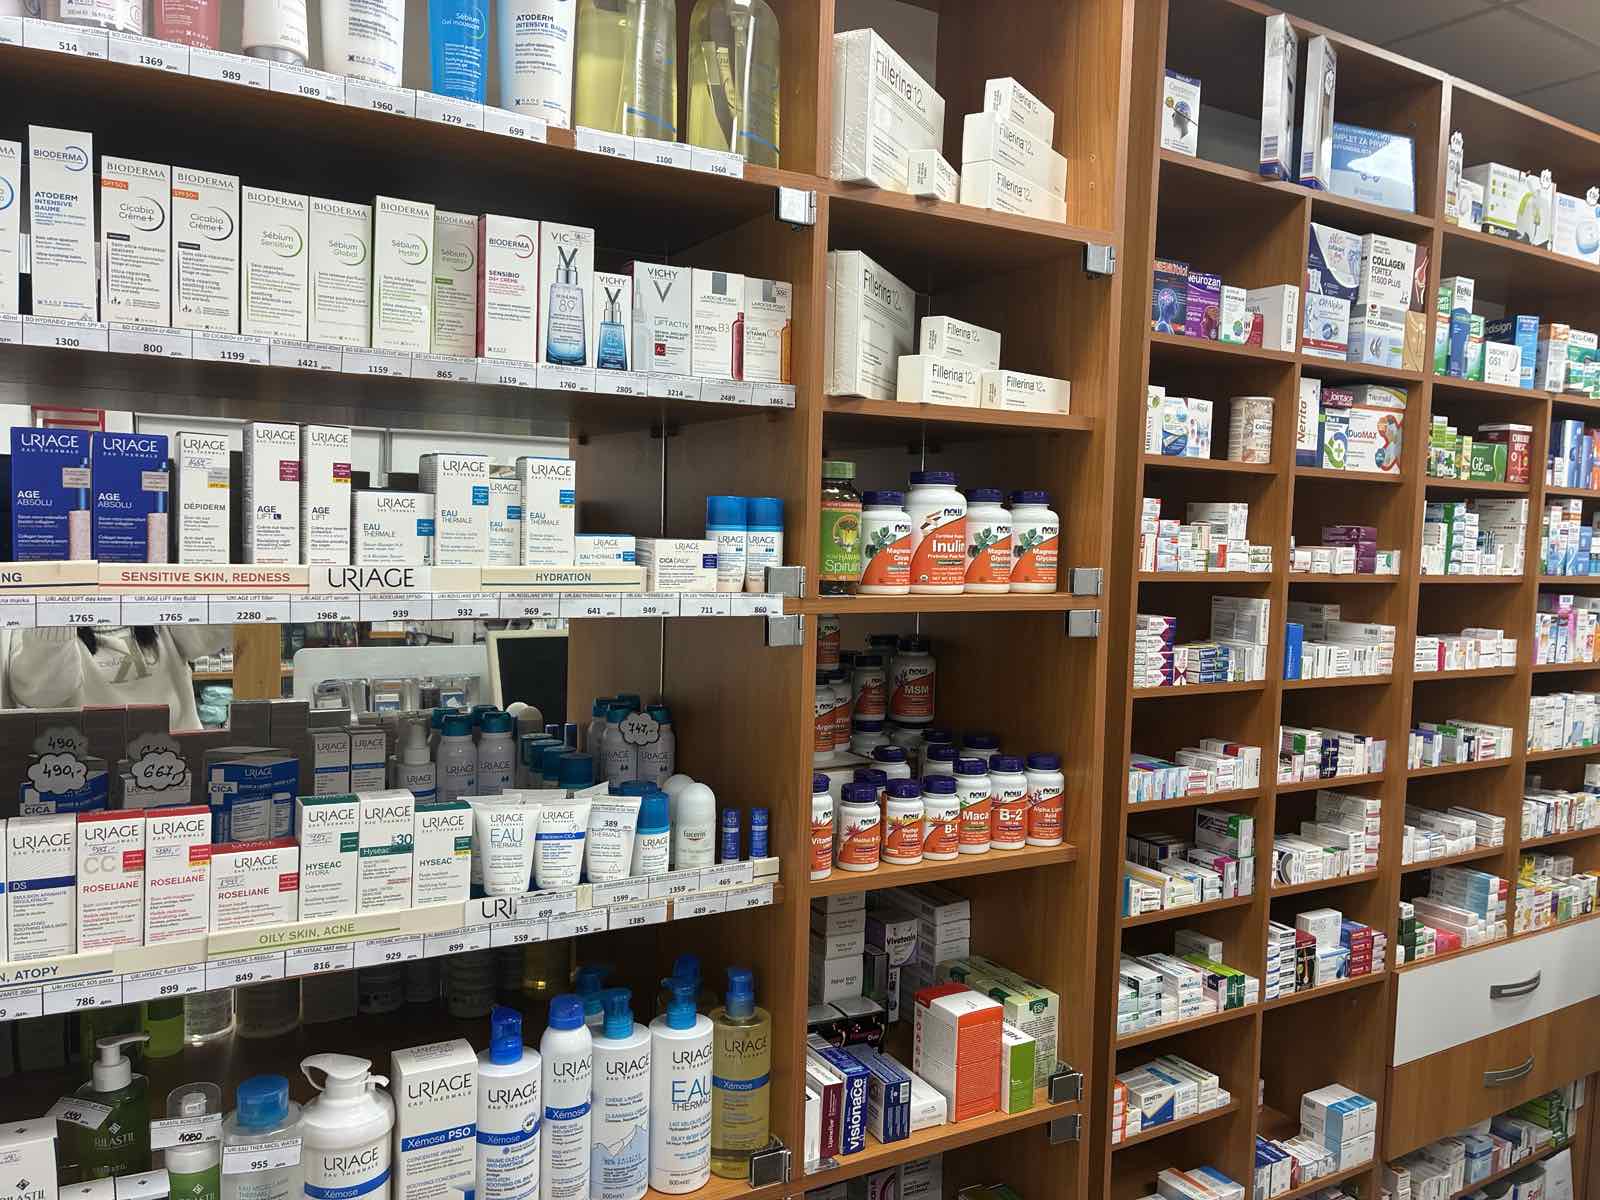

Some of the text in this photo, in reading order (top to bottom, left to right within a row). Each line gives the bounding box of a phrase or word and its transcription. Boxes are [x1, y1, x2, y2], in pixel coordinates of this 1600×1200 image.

[516, 14, 553, 22] ATODERM
[58, 41, 78, 53] 514
[139, 54, 163, 67] 1369
[221, 69, 241, 82] 989
[875, 51, 922, 110] Fillerina 12
[298, 84, 321, 97] 1089
[372, 99, 393, 112] 1960
[442, 114, 462, 124] 1279
[509, 127, 524, 136] 699
[33, 149, 83, 162] BIODERMA
[656, 156, 672, 164] 1100
[107, 162, 165, 178] BIODERMA
[178, 173, 234, 188] BIODERMA
[35, 192, 78, 201] ATODERM
[248, 192, 303, 208] BIODERMA
[35, 200, 72, 208] INTENSIVE
[35, 205, 60, 213] BAUME
[120, 203, 154, 215] Cicabio
[314, 202, 367, 218] BIODERMA
[380, 202, 429, 217] BIODERMA
[489, 238, 530, 249] BIODERMA
[1372, 256, 1406, 270] COLLAGEN
[489, 270, 520, 279] SENSIBIO
[648, 268, 678, 278] VICHY
[1372, 266, 1392, 277] FORTEX
[599, 276, 626, 286] VICHY
[1388, 278, 1401, 288] PLUS
[55, 337, 80, 347] 1300
[143, 344, 163, 353] 800
[220, 351, 245, 361] 1199
[297, 359, 318, 368] 1421
[368, 365, 388, 374] 1159
[932, 364, 973, 383] Fillerina 12
[499, 376, 517, 384] 1159
[559, 381, 576, 389] 1760
[1007, 376, 1043, 392] Fillerina 12
[256, 430, 295, 441] URIAGE
[312, 432, 348, 444] URIAGE
[1349, 430, 1376, 439] DuoMAX
[22, 434, 79, 448] URIAGE
[104, 438, 158, 453] URIAGE
[184, 440, 225, 450] URIAGE
[443, 461, 485, 473] URIAGE
[531, 465, 571, 478] URIAGE
[489, 483, 519, 493] URIAGE
[17, 491, 40, 499] AGE
[98, 493, 120, 501] AGE
[17, 498, 52, 506] ABSOLU
[98, 500, 132, 508] ABSOLU
[377, 499, 415, 510] URIAGE
[441, 510, 457, 518] EAU
[530, 512, 546, 520] EAU
[943, 508, 962, 517] now
[1041, 526, 1057, 535] now
[122, 572, 291, 583] SENSITIVE SKIN, REDNESS
[329, 568, 415, 591] URIAGE
[535, 572, 592, 582] HYDRATION
[457, 608, 473, 616] 932
[524, 607, 539, 615] 969
[587, 606, 601, 615] 641
[643, 606, 656, 614] 949
[159, 614, 182, 622] 1765
[237, 612, 261, 620] 2280
[317, 612, 338, 620] 1968
[909, 667, 928, 676] now
[904, 685, 929, 696] MSM
[211, 785, 233, 793] CICA
[309, 809, 354, 823] URIAGE
[365, 806, 411, 820] URIAGE
[490, 814, 524, 822] URIAGE
[543, 810, 575, 821] URIAGE
[963, 811, 989, 820] Maca
[1000, 809, 1022, 820] B-2
[423, 816, 464, 829] URIAGE
[84, 824, 138, 842] URIAGE
[153, 820, 205, 837] URIAGE
[491, 828, 524, 842] EAU
[13, 833, 71, 850] URIAGE
[83, 856, 116, 874] CC
[234, 855, 278, 870] URIAGE
[306, 861, 342, 871] HYSEAC
[420, 858, 452, 867] HYSEAC
[13, 881, 26, 890] DS
[150, 874, 205, 888] ROSELIANE
[83, 880, 139, 894] ROSELIANE
[218, 888, 270, 899] ROSELIANE
[613, 894, 629, 902] 1599
[259, 932, 284, 944] OILY
[323, 923, 354, 936] ACNE
[514, 935, 528, 943] 559
[449, 943, 463, 951] 899
[385, 952, 401, 960] 929
[313, 962, 330, 970] 816
[15, 966, 59, 980] ATOPY
[235, 973, 253, 982] 849
[160, 985, 178, 994] 899
[76, 996, 95, 1006] 786
[724, 1037, 768, 1053] URIAGE
[408, 1073, 472, 1100] URIAGE
[488, 1080, 537, 1106] URIAGE
[552, 1107, 585, 1119] Xémose
[849, 1079, 862, 1150] visionace
[408, 1128, 471, 1149] Xémose PSO
[324, 1147, 379, 1171] URIAGE
[251, 1161, 268, 1169] 955
[323, 1189, 357, 1199] Xémose
